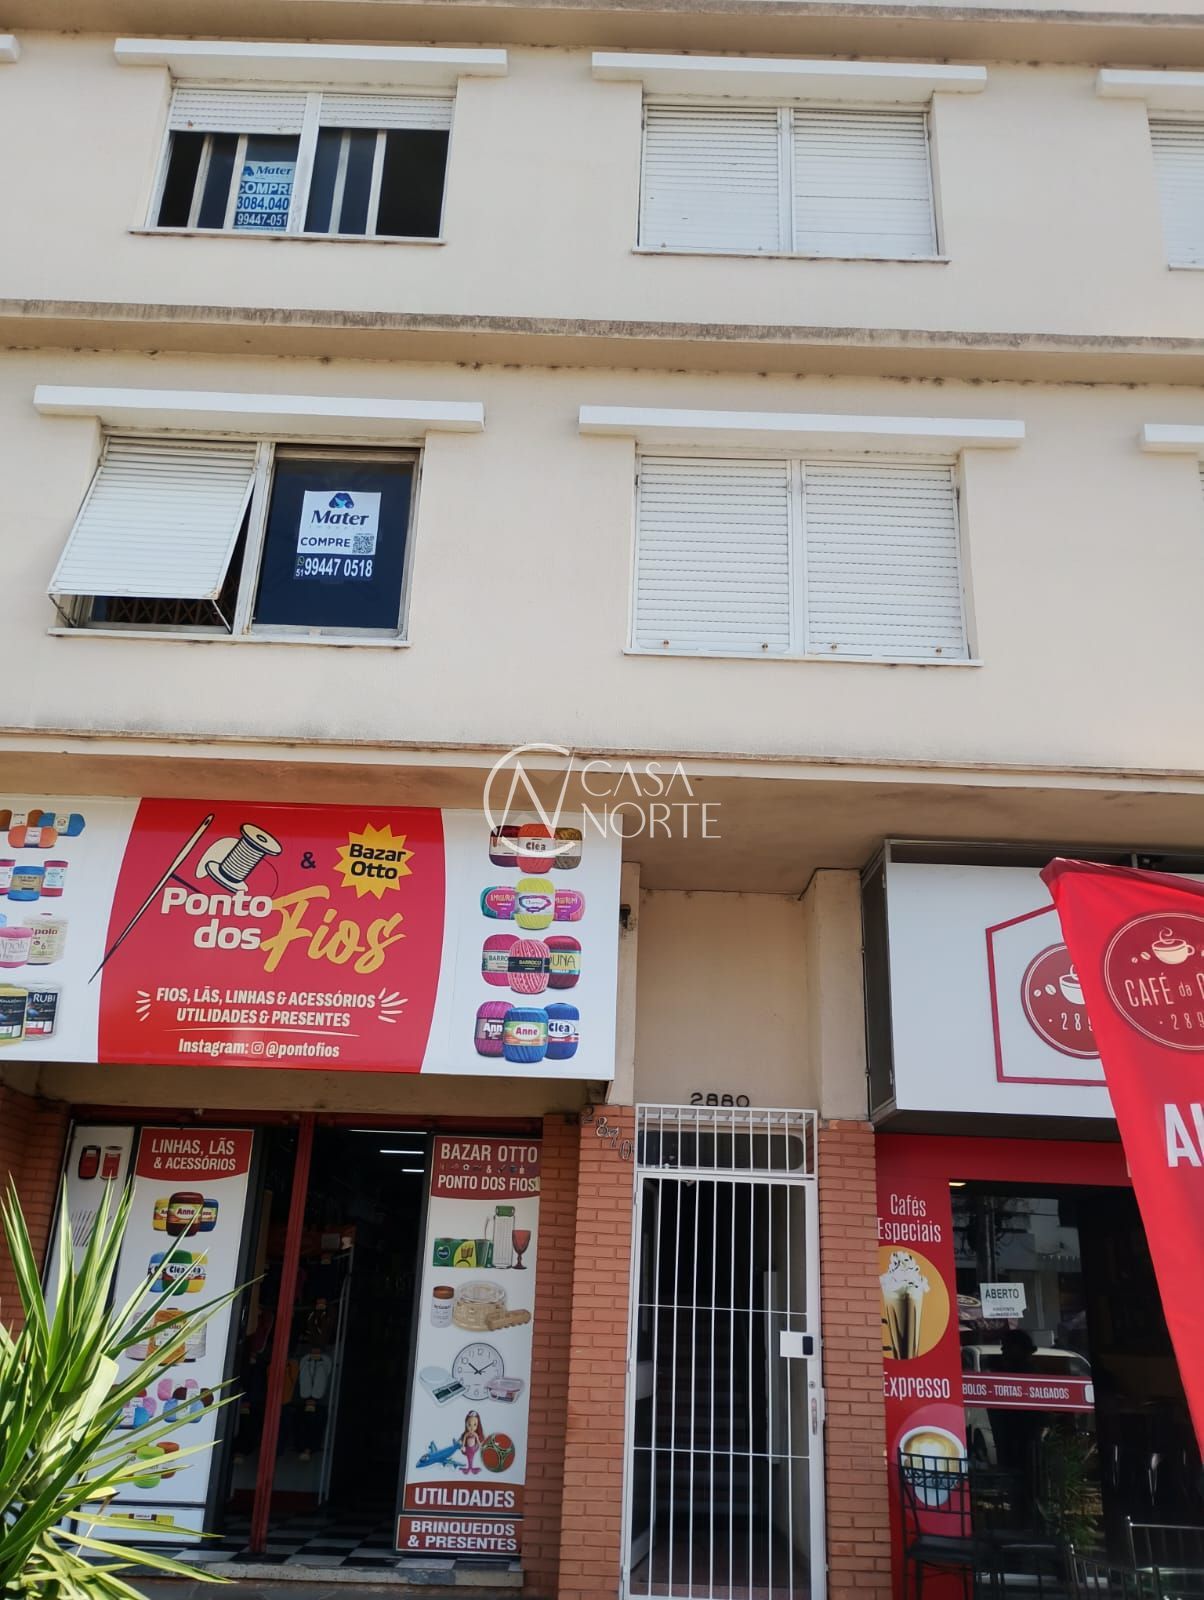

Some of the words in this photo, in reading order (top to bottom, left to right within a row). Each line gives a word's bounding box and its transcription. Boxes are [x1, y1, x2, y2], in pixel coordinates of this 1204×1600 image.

[256, 165, 293, 175] Mater
[240, 181, 294, 195] COMPR
[311, 509, 369, 526] Mater
[301, 536, 351, 547] COMPRE
[305, 557, 341, 576] 99447
[344, 559, 373, 577] 0518
[525, 842, 547, 851] Clea
[300, 851, 316, 869] &
[349, 843, 406, 863] Bazar
[350, 860, 398, 880] Otto
[161, 887, 273, 917] Ponto
[194, 919, 261, 950] dos
[260, 885, 407, 974] Fios
[33, 994, 56, 1002] RUBI
[156, 987, 191, 1005] FIOS,
[193, 985, 223, 1006] LÃS,
[225, 990, 275, 1005] LINHAS
[277, 991, 287, 1005] &
[288, 990, 376, 1009] ACESSÓRIOS
[1124, 972, 1174, 1007] CAFÉ
[1178, 981, 1193, 997] da
[176, 1008, 258, 1024] UTILIDADES
[259, 1010, 270, 1025] &
[271, 1010, 351, 1027] PRESENTES
[515, 1026, 538, 1036] Anne
[549, 1021, 570, 1033] Clea
[178, 1038, 249, 1057] Instagram:
[265, 1040, 340, 1058] @pontofios
[690, 1092, 750, 1108] 2880
[151, 1138, 204, 1156] LINHAS,
[208, 1137, 235, 1155] LÃS
[441, 1143, 491, 1162] BAZAR
[497, 1146, 538, 1164] OTTO
[153, 1157, 162, 1169] &
[165, 1155, 236, 1171] ACESSÓRIOS
[437, 1175, 478, 1190] PONTO
[481, 1176, 506, 1191] DOS
[509, 1178, 536, 1192] FIOS
[890, 1193, 926, 1217] Cafés
[877, 1217, 942, 1243] Especiais
[985, 1288, 1020, 1299] ABERTO
[962, 1383, 987, 1396] BOLOS
[994, 1384, 1022, 1397] TORTAS
[1029, 1387, 1069, 1400] SALGADOS
[414, 1487, 515, 1508] UTILIDADES
[410, 1520, 515, 1537] BRINQUEDOS
[407, 1535, 420, 1548] &
[425, 1536, 517, 1551] PRESENTES
